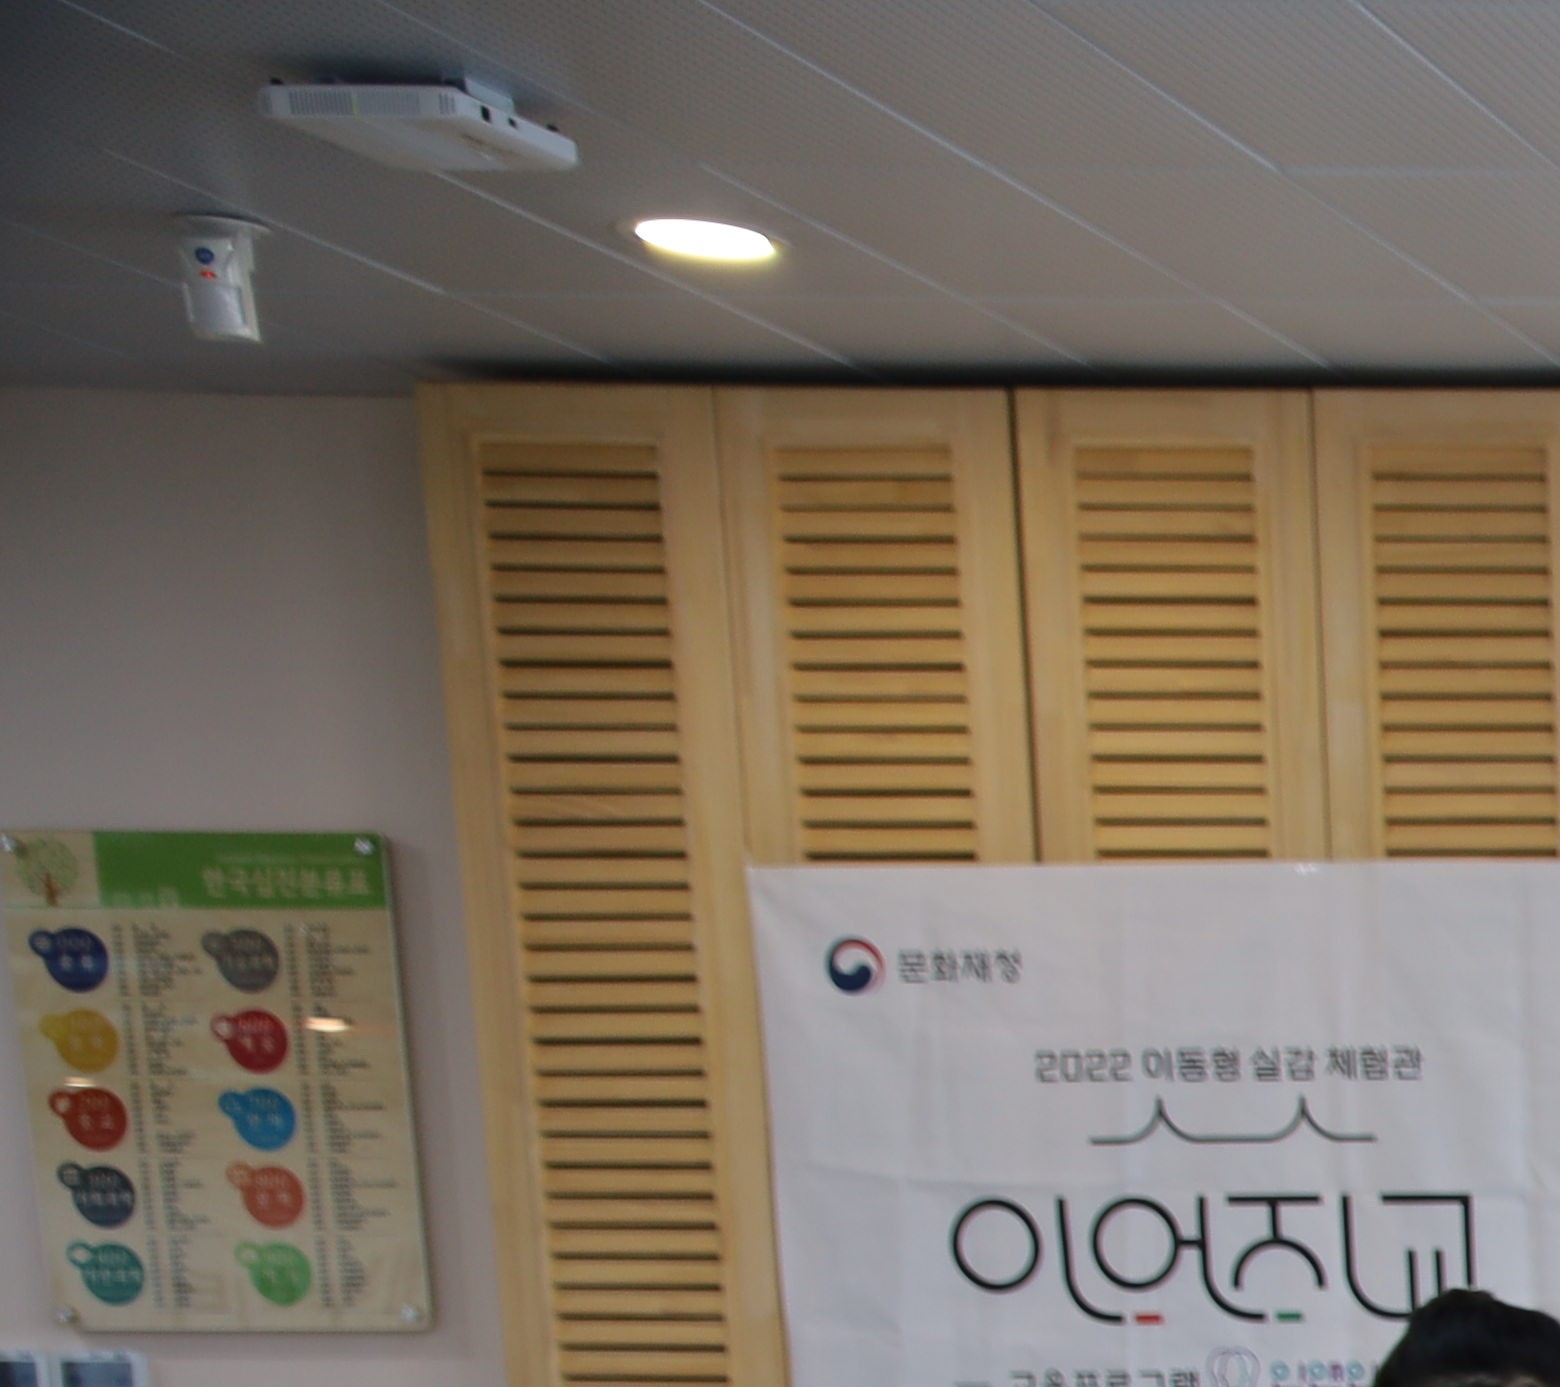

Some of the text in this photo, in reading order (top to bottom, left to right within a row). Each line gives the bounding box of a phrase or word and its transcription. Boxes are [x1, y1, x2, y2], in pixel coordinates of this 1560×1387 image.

[898, 950, 1023, 984] 문화재청
[1034, 1044, 1424, 1083] 2022 이동형 실감 체험관
